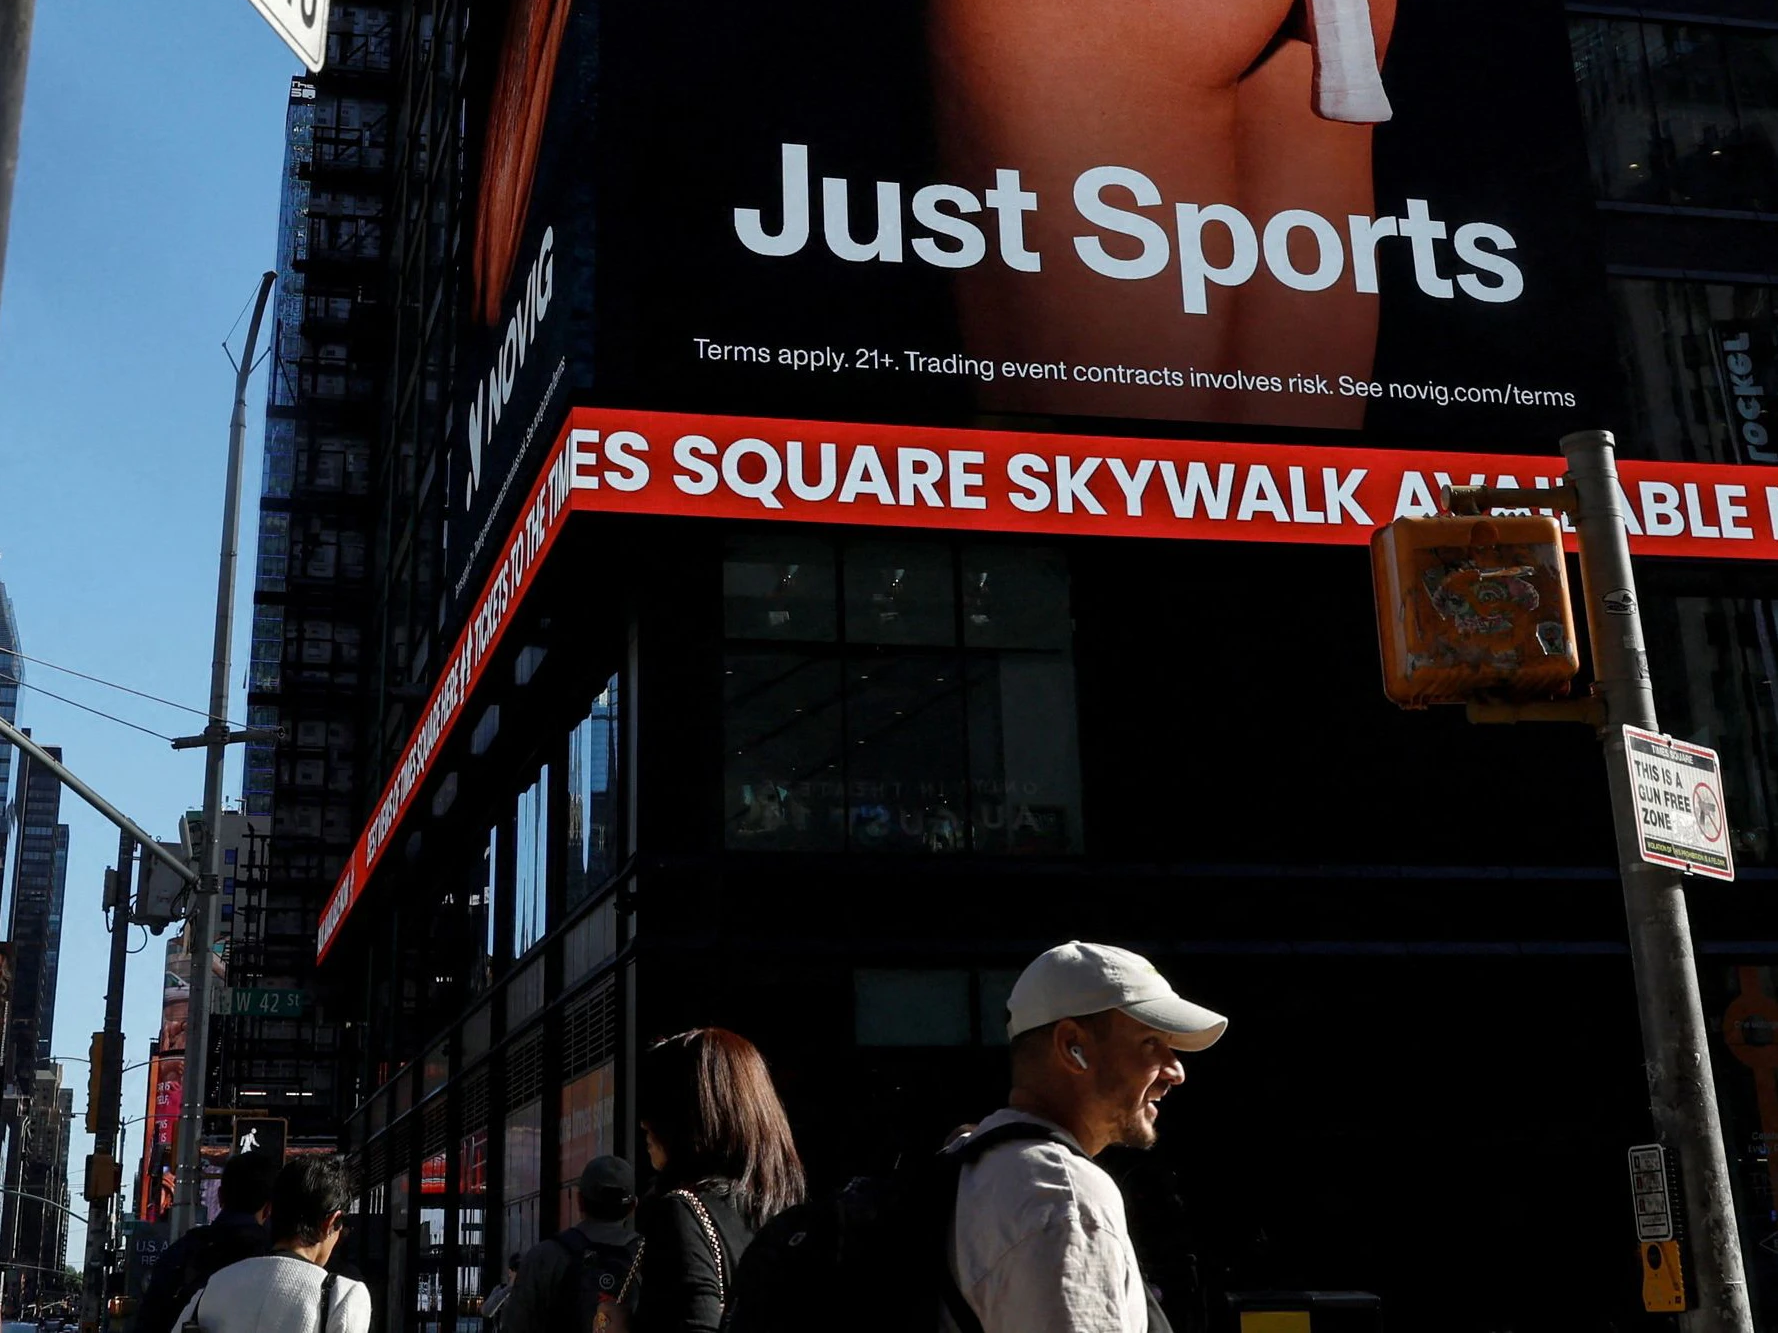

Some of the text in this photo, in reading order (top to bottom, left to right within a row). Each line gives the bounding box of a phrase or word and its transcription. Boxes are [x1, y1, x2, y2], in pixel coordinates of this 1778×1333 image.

[734, 143, 1524, 314] Just Sports
[487, 225, 553, 446] NOVIG
[694, 338, 1576, 408] Terms apply. 21+. Trading event contracts involves risk. See novig.com/terms
[416, 693, 442, 776] SQUARE
[441, 657, 460, 732] HERE
[475, 558, 509, 666] TICKETS
[510, 531, 525, 598] TO
[526, 482, 546, 570] THE
[672, 435, 987, 509] SQUARE
[1006, 453, 1374, 525] SKYWALK
[1634, 760, 1683, 789] THIS IS A
[1639, 784, 1691, 813] GUN FREE
[1642, 807, 1672, 830] ZONE
[236, 992, 299, 1013] W 42 St
